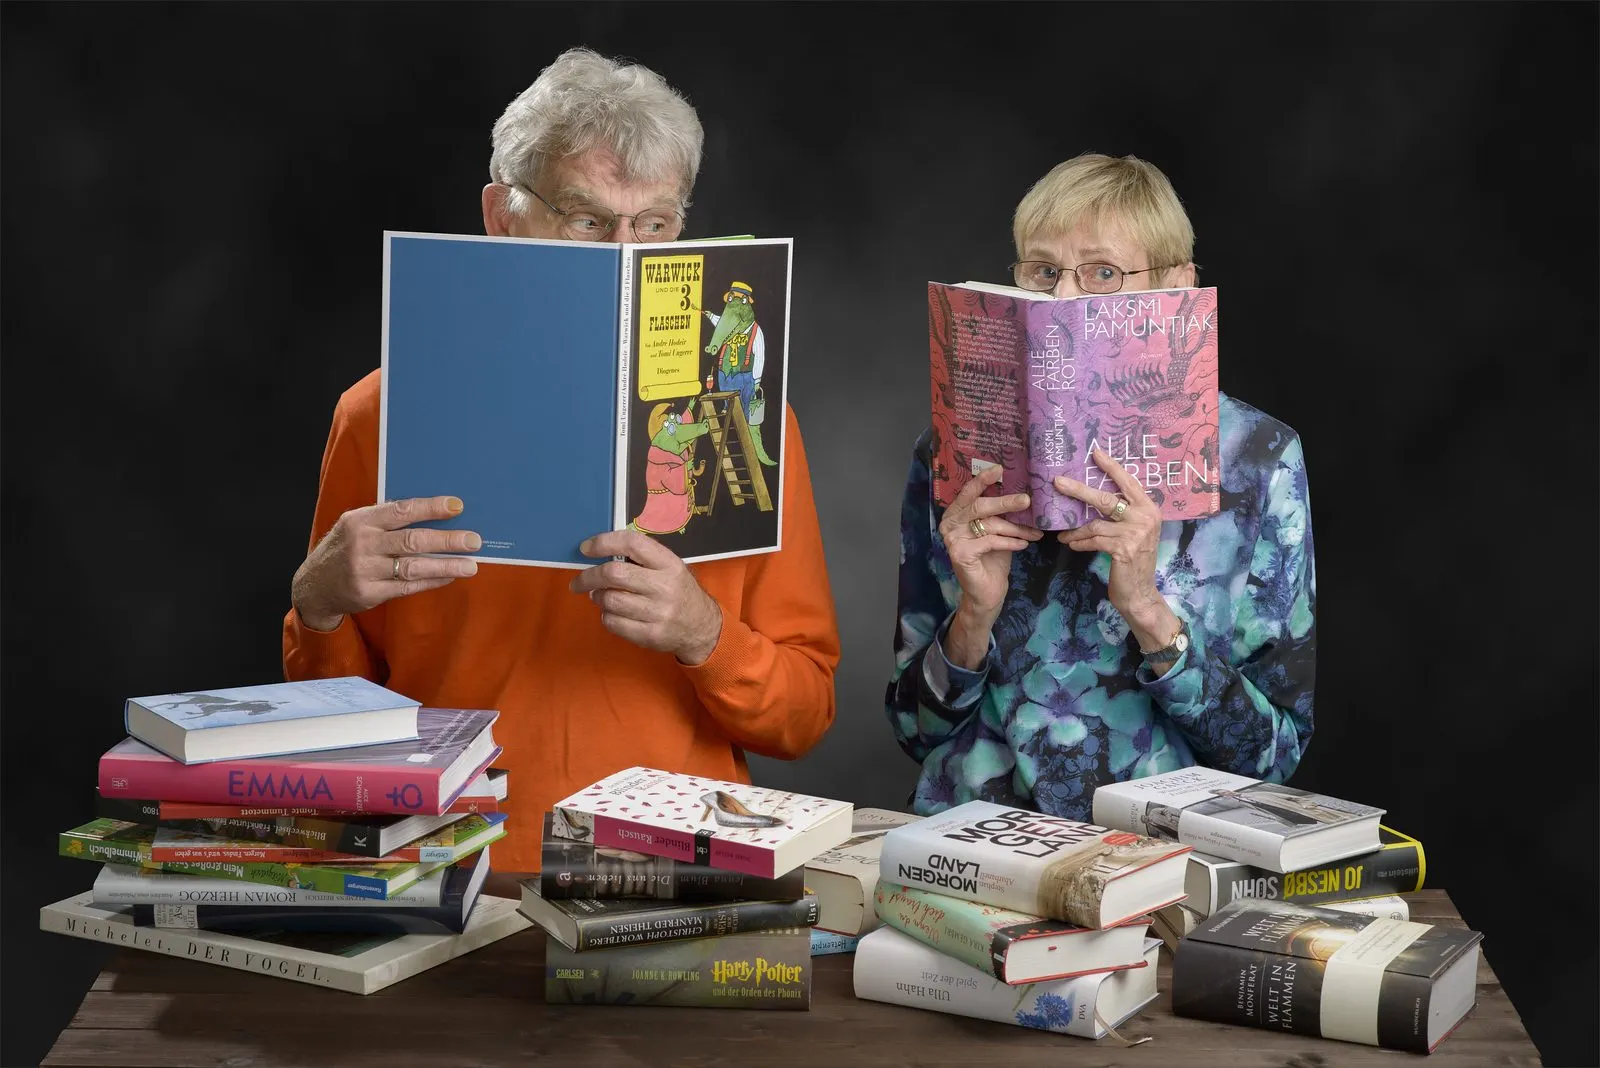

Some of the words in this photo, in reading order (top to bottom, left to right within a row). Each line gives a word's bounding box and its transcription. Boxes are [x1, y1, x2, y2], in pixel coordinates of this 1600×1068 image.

[645, 262, 701, 283] WARWICK
[680, 284, 691, 311] 3
[1084, 298, 1163, 321] LAKSMI
[649, 314, 691, 331] FLASCHEN
[1084, 313, 1214, 340] PAMUNTJAK
[672, 349, 693, 357] Ungerer
[1046, 325, 1060, 390] FARBEN
[656, 367, 680, 375] Diogenes
[1031, 349, 1045, 391] ALLE
[1061, 354, 1075, 390] ROT
[1055, 404, 1063, 467] PAMUNTJAK
[1046, 429, 1054, 467] LAKSMI
[1084, 434, 1158, 464] ALLE
[228, 770, 334, 801] EMMA
[142, 806, 160, 816] 1800
[241, 808, 292, 816] Tummetott
[294, 808, 319, 816] Tomte
[228, 820, 270, 832] Frankfurter
[943, 809, 1041, 843] MOR
[354, 834, 367, 847] K
[617, 828, 652, 844] Rausch
[654, 836, 691, 853] Blinder
[175, 850, 191, 858] geben
[424, 851, 449, 859] Oetinger
[222, 864, 244, 878] Mein
[928, 854, 980, 878] LAND
[558, 870, 572, 882] a
[588, 874, 622, 885] lieben
[626, 874, 646, 883] uns
[651, 874, 671, 885] Die
[680, 874, 709, 886] Blum
[898, 863, 978, 894] MORGEN
[1345, 867, 1363, 890] JO
[347, 883, 382, 893] Ravensburger
[978, 881, 1005, 893] Stephan
[1231, 876, 1278, 900] SOHN
[1283, 871, 1340, 899] NESBØ
[178, 890, 240, 902] HERZOG
[245, 890, 297, 902] ROMAN
[888, 890, 921, 914] traust
[806, 902, 816, 924] List
[898, 912, 911, 928] du
[922, 903, 945, 924] dich
[610, 919, 652, 934] THEISEN
[652, 915, 703, 931] MANFRED
[1242, 918, 1278, 937] WELT
[589, 931, 644, 946] WORTBERG
[646, 925, 703, 940] CHRISTOPH
[913, 919, 940, 945] Wenn
[944, 926, 969, 944] GEMBRI
[811, 939, 847, 951] Hotzenplo
[968, 938, 985, 953] KIRA
[187, 942, 230, 963] DER
[246, 953, 332, 983] VOGEL.
[555, 968, 585, 980] CARLSEN
[631, 969, 659, 981] JOANNE
[660, 970, 667, 981] K.
[668, 970, 700, 982] ROWLING
[711, 960, 755, 986] Harry
[755, 957, 803, 986] Potter
[920, 971, 938, 984] Zeit
[1271, 964, 1282, 980] IN
[896, 981, 926, 997] Hahn
[940, 976, 955, 986] der
[959, 978, 978, 990] Spiel
[1237, 968, 1247, 1009] BENJAMIN
[712, 987, 726, 997] und
[727, 987, 739, 997] der
[741, 987, 762, 997] Orden
[763, 987, 776, 998] des
[777, 987, 802, 998] Phönix
[928, 987, 951, 1002] Ulla
[1247, 963, 1258, 1017] MONFERAT
[1282, 961, 1297, 1030] FLAMMEN
[1078, 1003, 1087, 1021] DVA
[1269, 989, 1281, 1023] WELT
